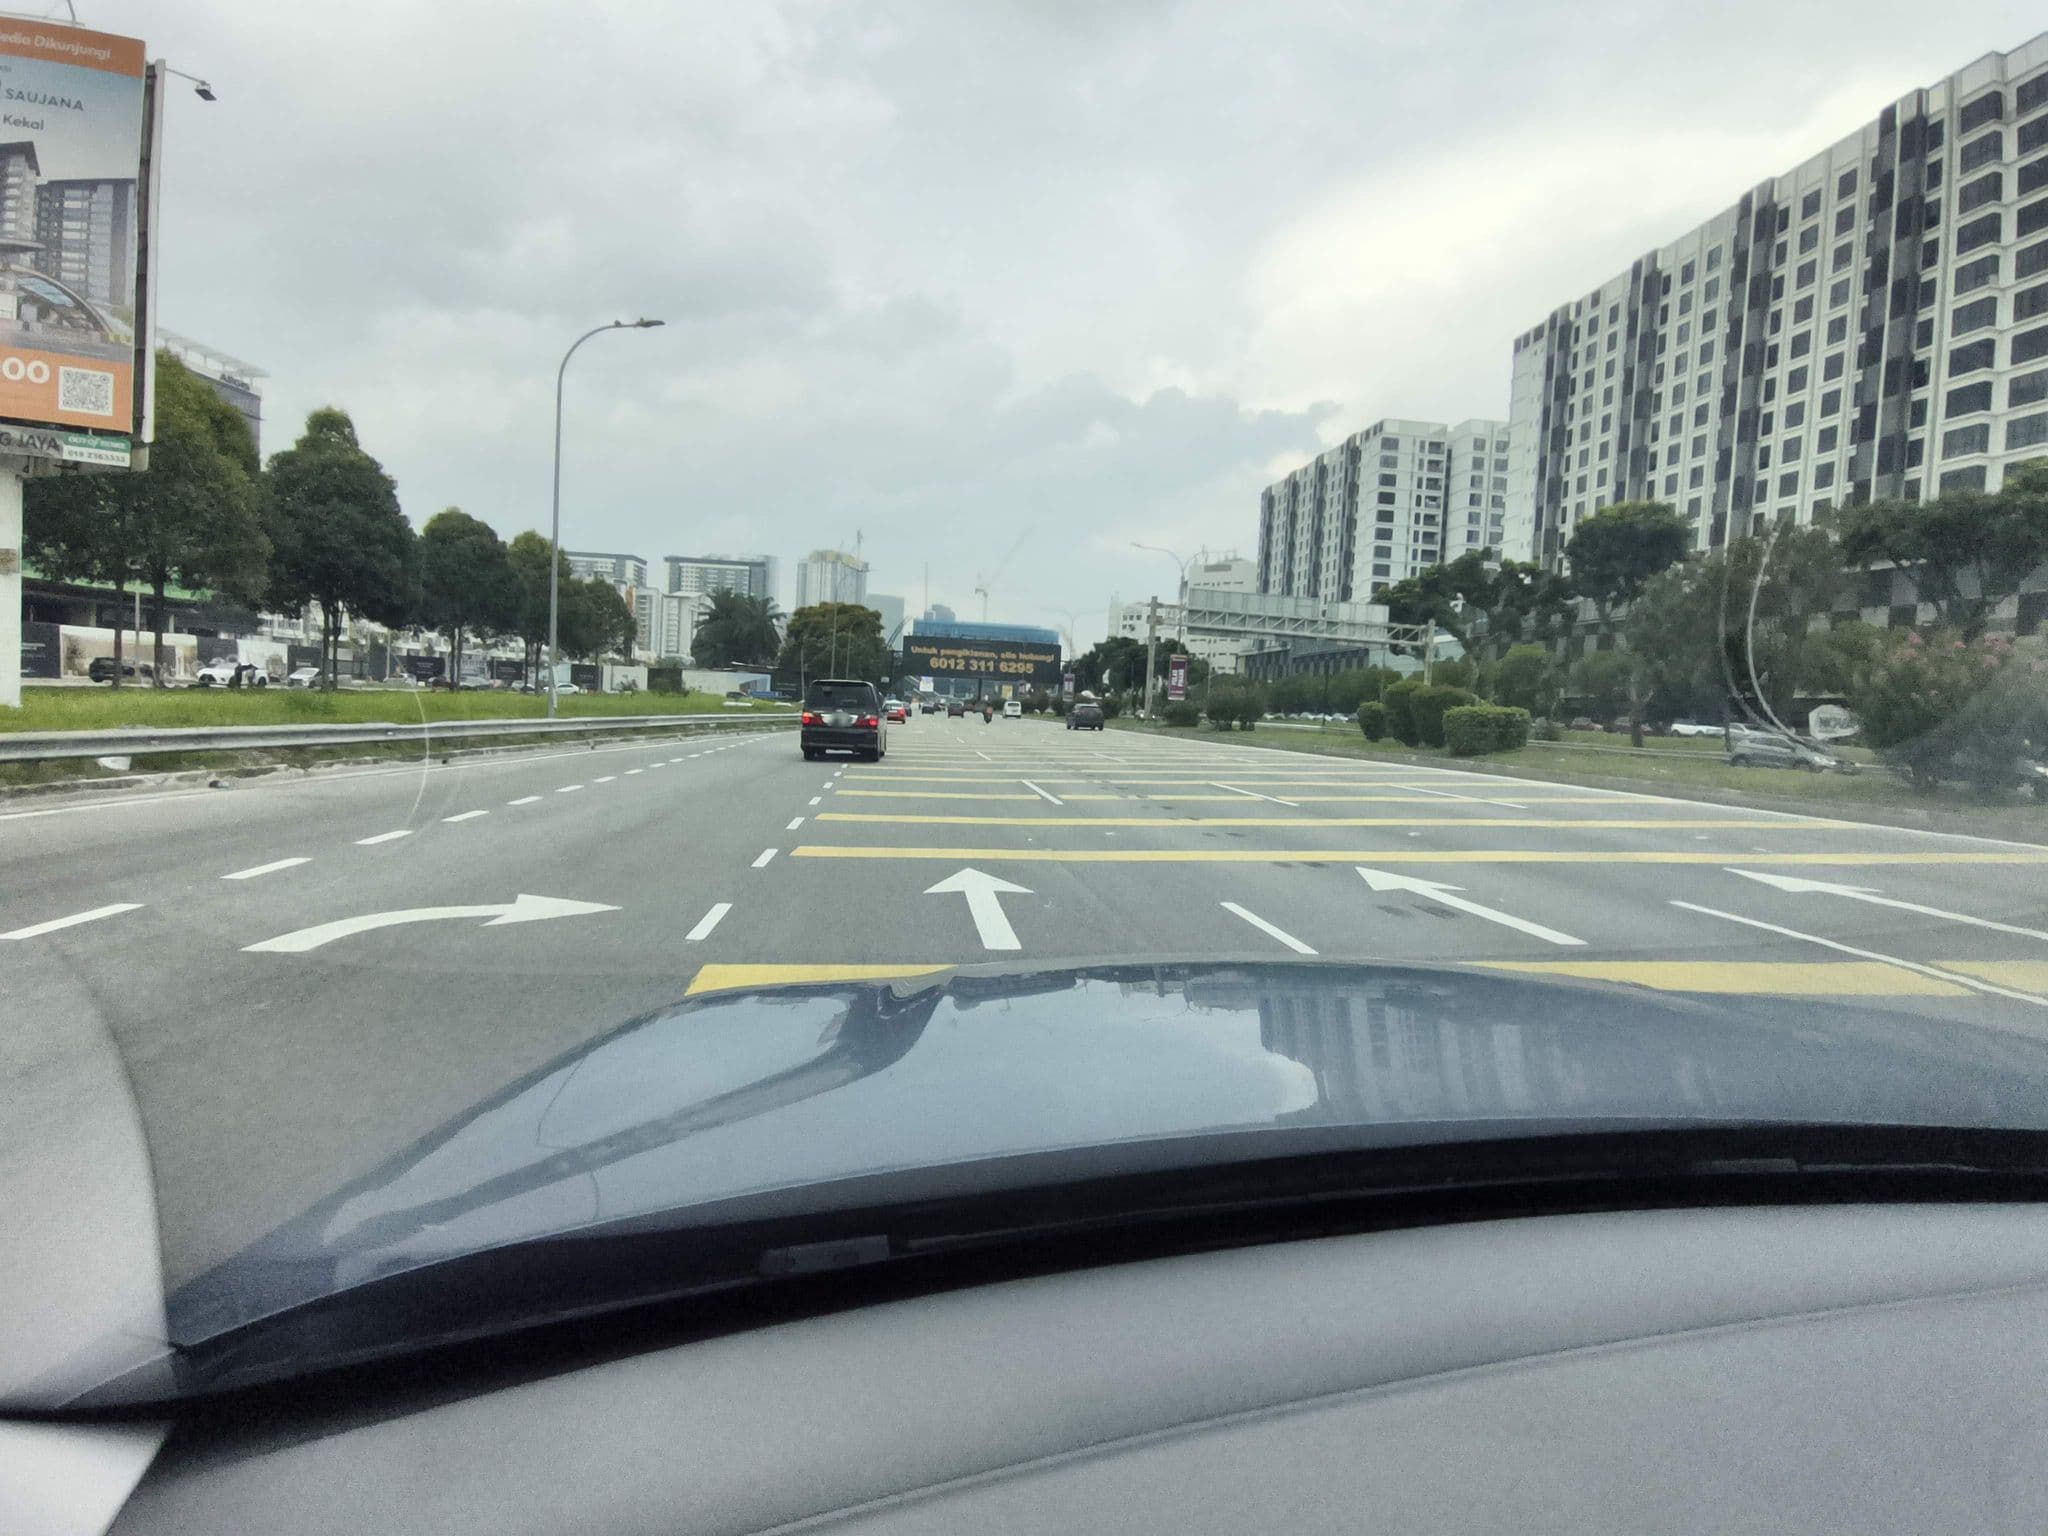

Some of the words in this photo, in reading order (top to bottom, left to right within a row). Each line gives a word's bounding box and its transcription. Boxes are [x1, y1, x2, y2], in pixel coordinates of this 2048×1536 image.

[34, 35, 111, 60] Dikunjungi
[6, 88, 84, 111] SAUJANA
[3, 113, 44, 130] Kekal
[16, 432, 60, 451] JAYA
[911, 646, 938, 655] Untuk
[929, 657, 966, 670] 6012
[969, 659, 995, 672] 311
[999, 661, 1035, 674] 6295
